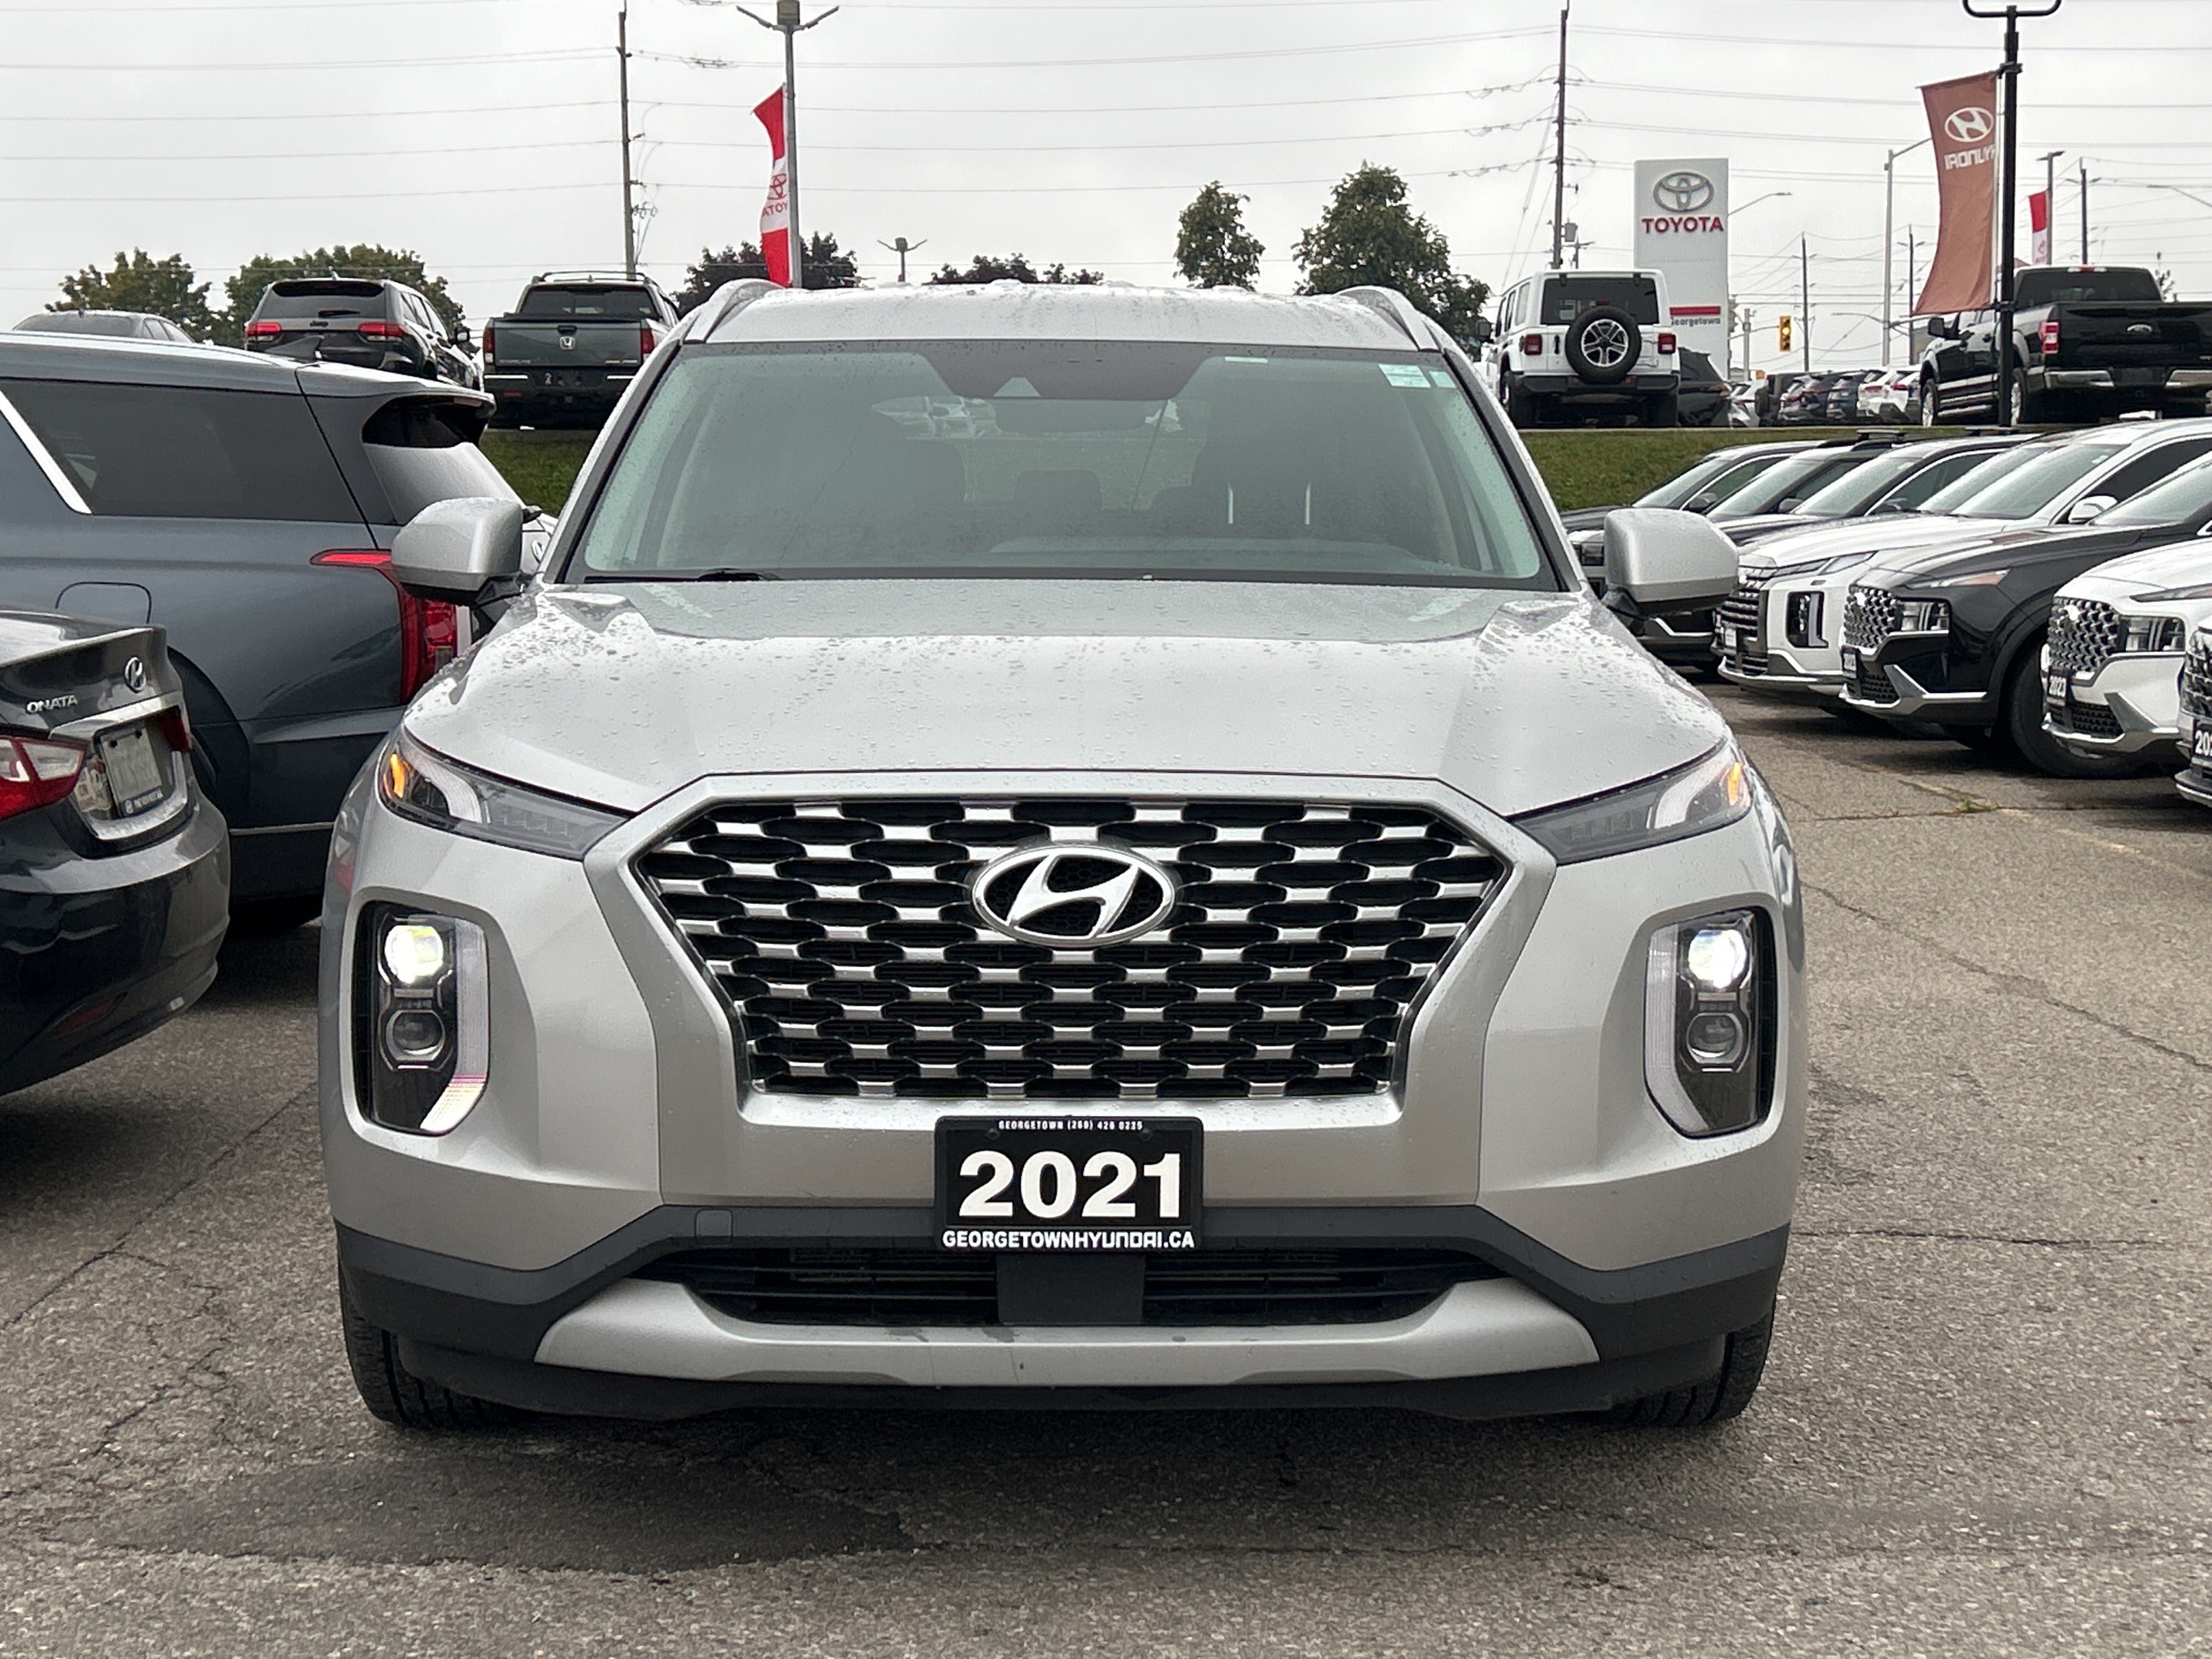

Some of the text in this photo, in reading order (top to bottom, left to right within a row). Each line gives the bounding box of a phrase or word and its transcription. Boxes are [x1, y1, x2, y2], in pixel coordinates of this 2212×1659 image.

[1642, 217, 1724, 233] TOYOTA
[998, 1120, 1064, 1130] GEORGETOWN
[959, 1151, 1181, 1218] 2021
[942, 1230, 1195, 1249] GEORGETOWNHYUNDAI.CA
